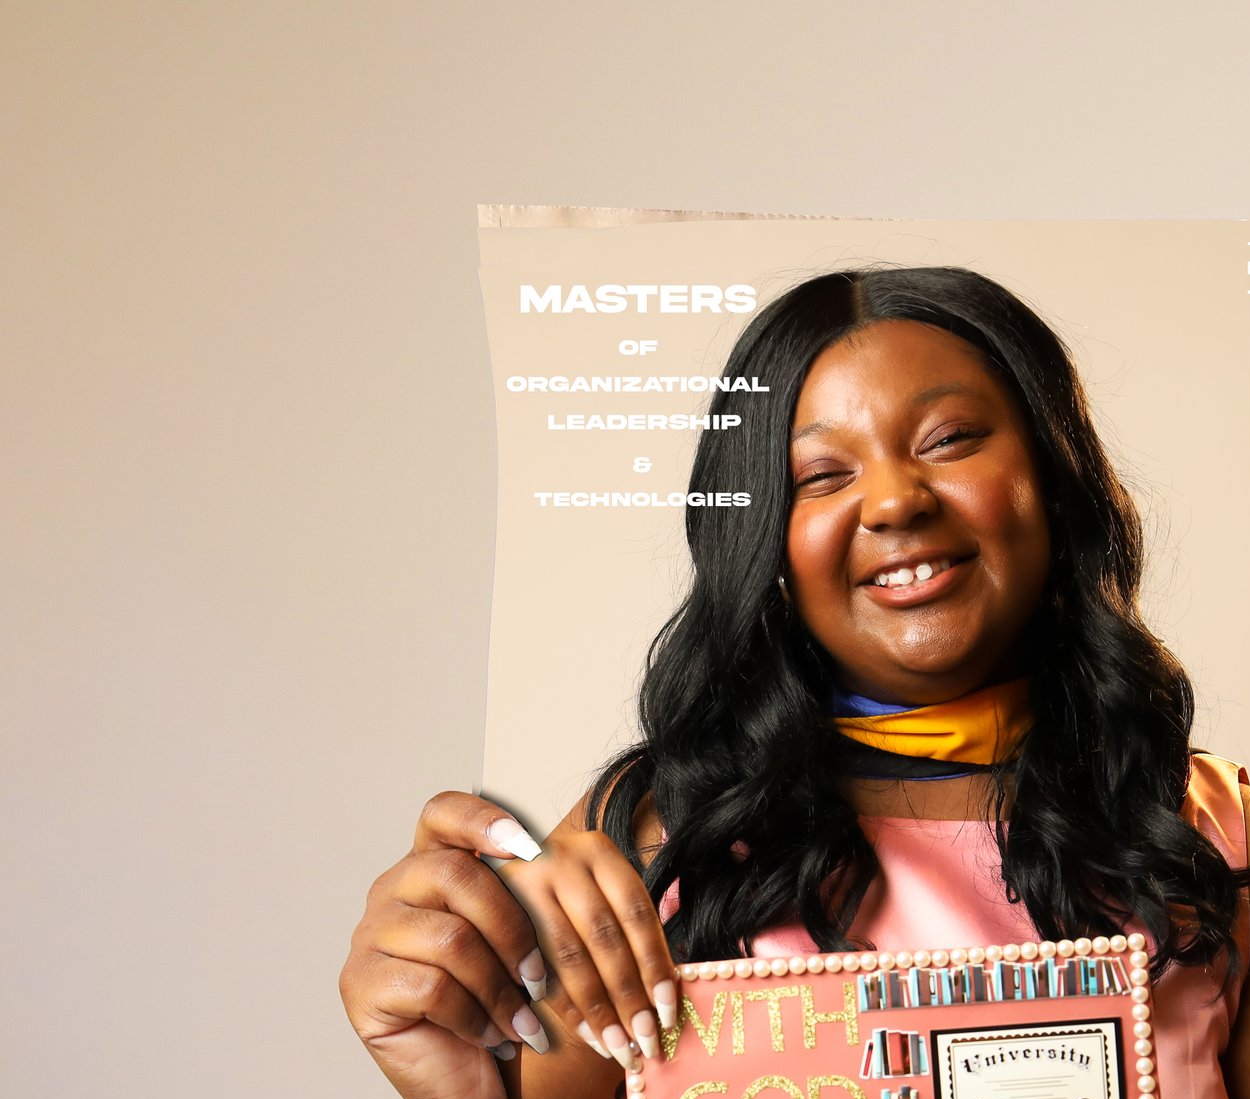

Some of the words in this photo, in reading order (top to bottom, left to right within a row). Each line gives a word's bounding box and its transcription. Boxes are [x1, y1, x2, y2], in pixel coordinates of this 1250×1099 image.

[519, 284, 758, 314] MASTERS
[618, 339, 659, 357] OF
[506, 376, 771, 394] ORGANIZATIONAL
[547, 414, 743, 432] LEADERSHIP
[633, 457, 654, 474] &
[534, 491, 753, 508] TECHNOLOGIES
[962, 1044, 1091, 1075] University
